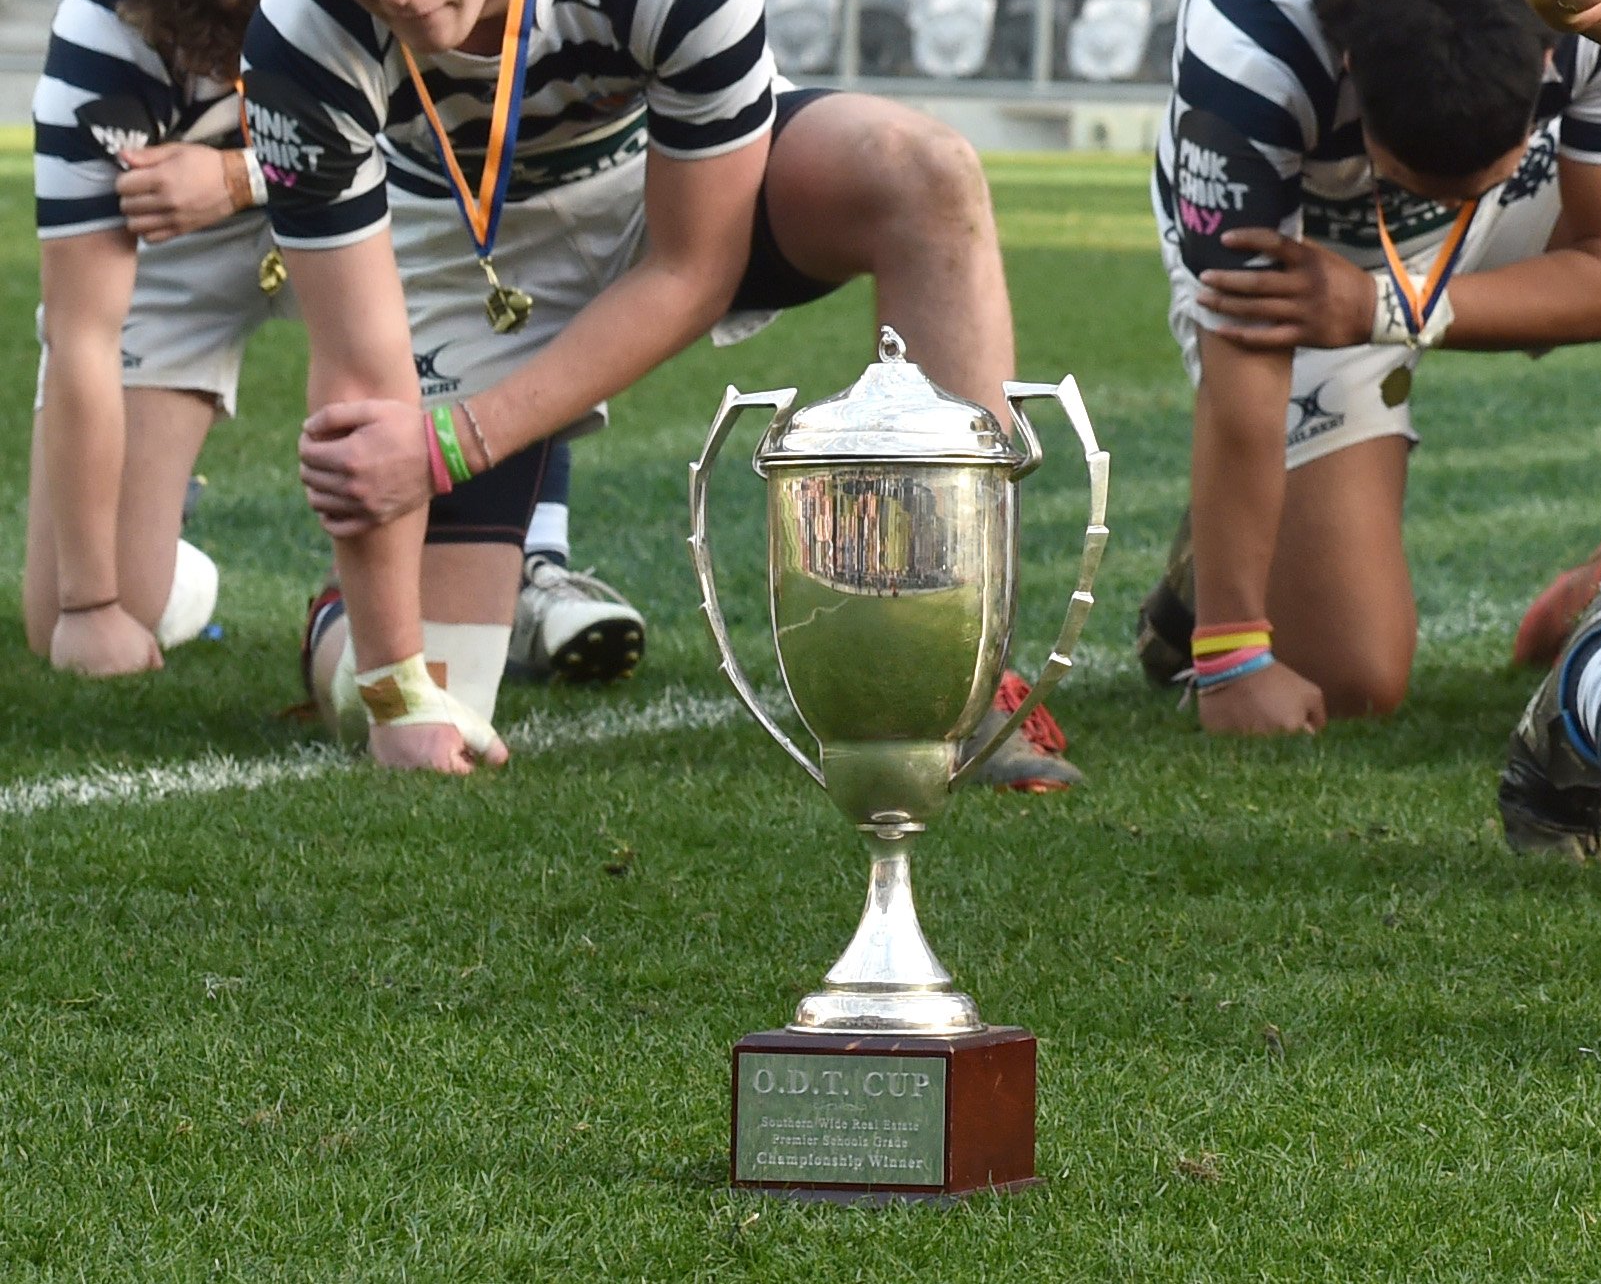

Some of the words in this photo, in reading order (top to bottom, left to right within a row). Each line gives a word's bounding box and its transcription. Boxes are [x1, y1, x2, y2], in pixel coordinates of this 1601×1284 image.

[1179, 138, 1229, 183] PINK
[752, 1068, 850, 1096] O.D.T.
[862, 1071, 930, 1098] CUP
[760, 1116, 814, 1130] Southern
[818, 1117, 848, 1131] Wide
[851, 1118, 879, 1132] Real
[882, 1119, 920, 1133] Estate
[772, 1134, 819, 1147] Premier
[822, 1135, 869, 1149] Schools
[873, 1136, 909, 1149] Grade
[756, 1151, 863, 1169] Championship
[867, 1154, 925, 1169] Winner
